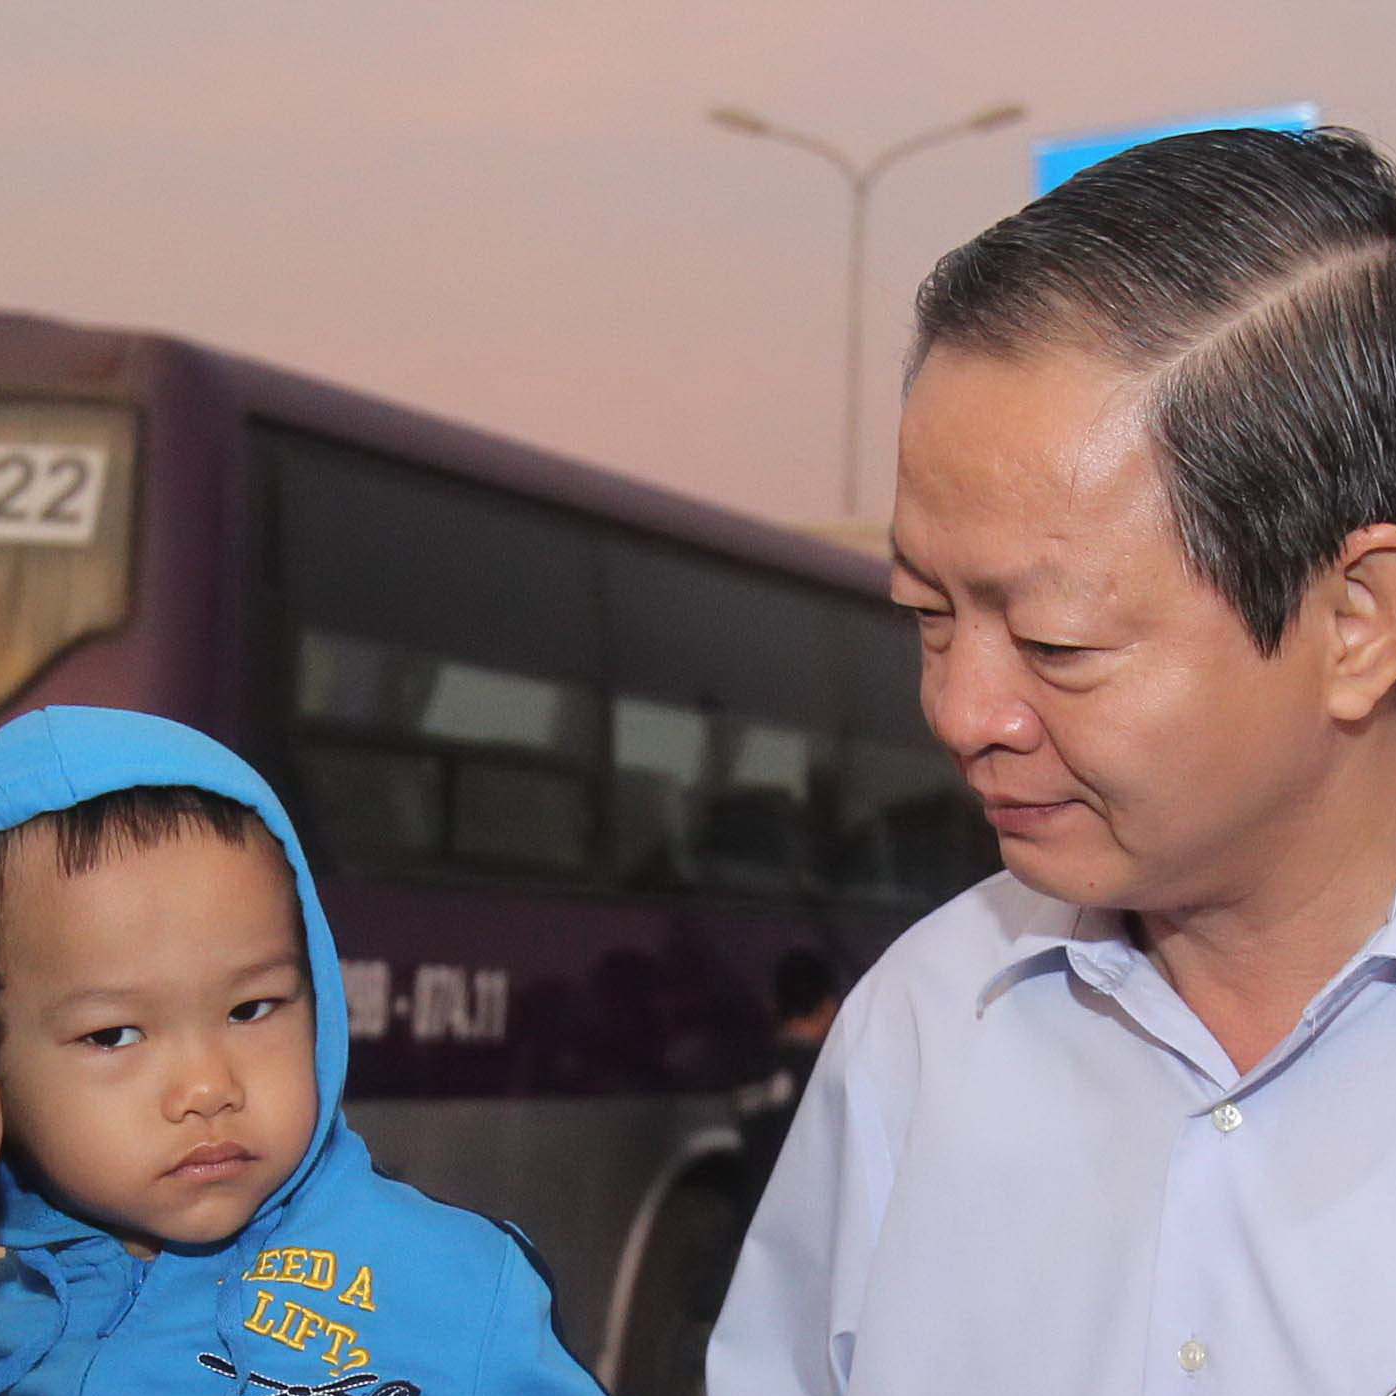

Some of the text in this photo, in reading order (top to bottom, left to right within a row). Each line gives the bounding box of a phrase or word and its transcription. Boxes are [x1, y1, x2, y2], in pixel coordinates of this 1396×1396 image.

[242, 1248, 376, 1312] EED A
[244, 1290, 371, 1377] LIFT?
